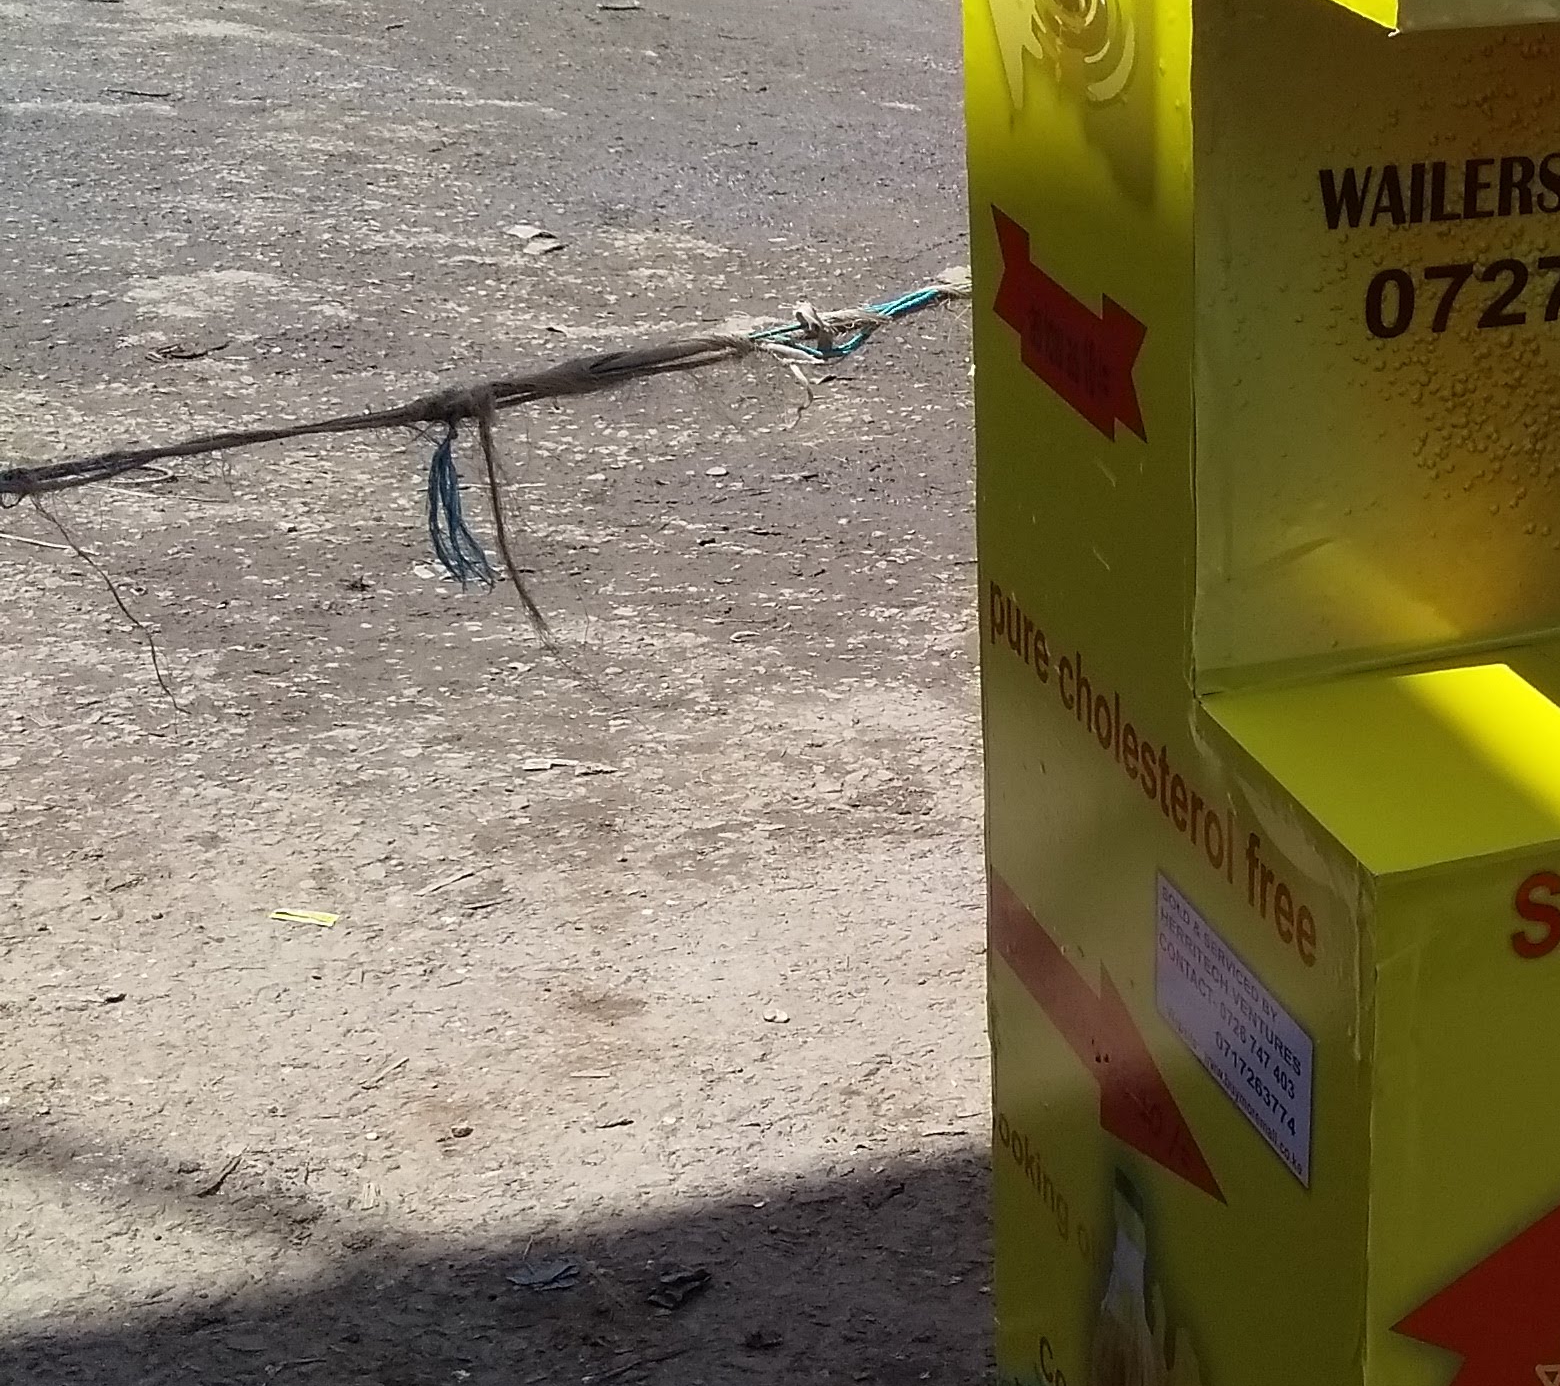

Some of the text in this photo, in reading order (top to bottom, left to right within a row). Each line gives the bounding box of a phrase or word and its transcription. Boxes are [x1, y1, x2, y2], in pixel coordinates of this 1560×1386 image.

[990, 579, 1317, 968] pure cholesterol free
[1162, 886, 1191, 926] SOLD
[1203, 932, 1259, 1003] SERVICED
[1262, 996, 1278, 1023] BY
[1232, 987, 1301, 1076] VENTURES
[1250, 1035, 1270, 1069] 747
[1273, 1065, 1295, 1100] 403
[992, 1112, 1070, 1242] ooking
